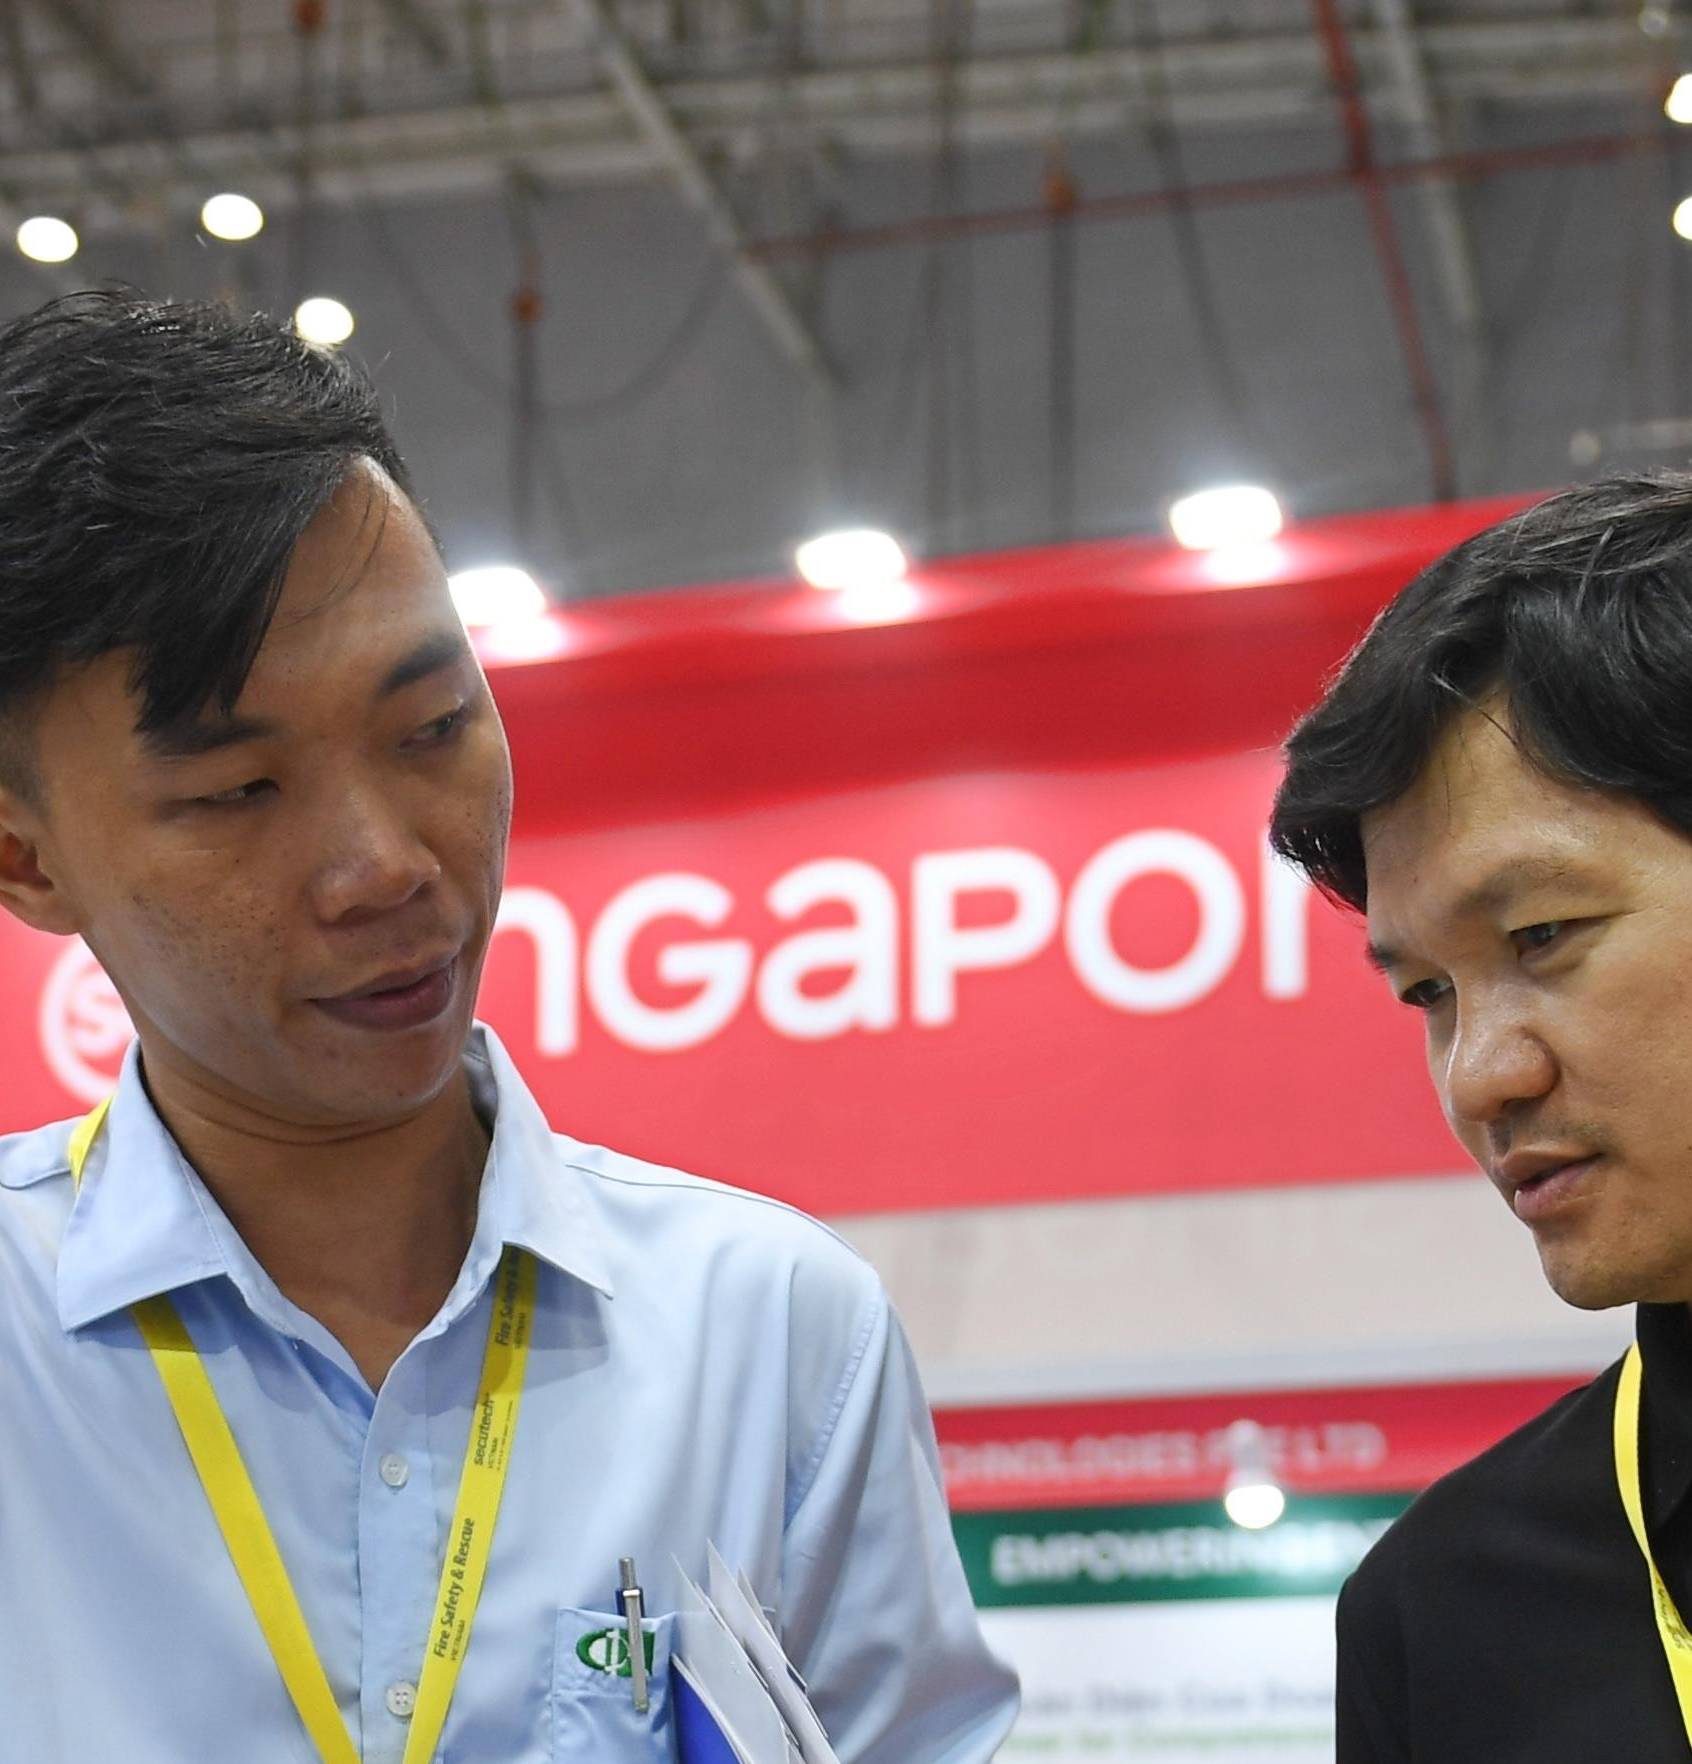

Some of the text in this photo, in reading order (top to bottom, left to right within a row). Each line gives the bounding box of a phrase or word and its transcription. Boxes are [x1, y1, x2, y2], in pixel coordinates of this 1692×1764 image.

[474, 1397, 495, 1466] secutech
[433, 1516, 476, 1659] Fire Safety & Rescue
